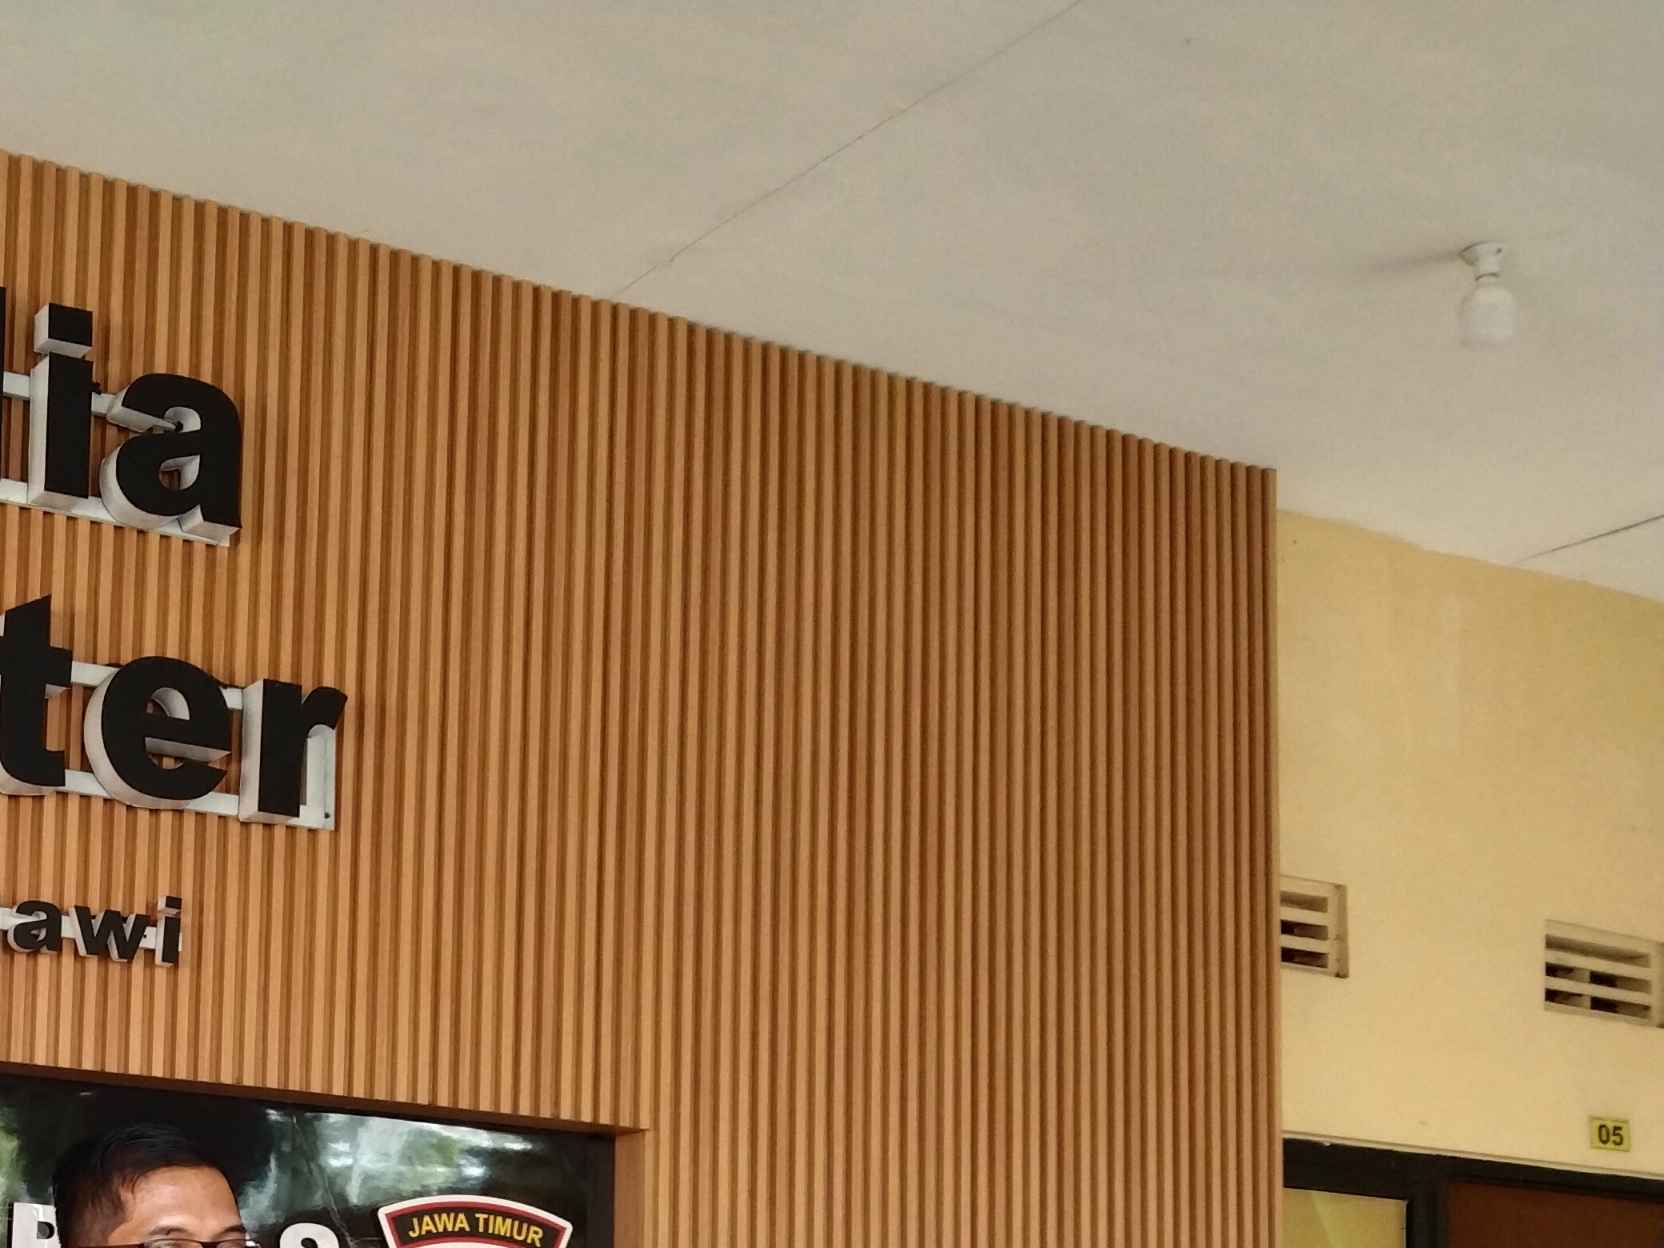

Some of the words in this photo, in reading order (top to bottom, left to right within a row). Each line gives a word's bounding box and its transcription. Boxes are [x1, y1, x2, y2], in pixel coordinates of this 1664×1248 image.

[1598, 1124, 1624, 1146] 05
[408, 1212, 470, 1238] JAWA
[474, 1213, 543, 1247] TIMUR
